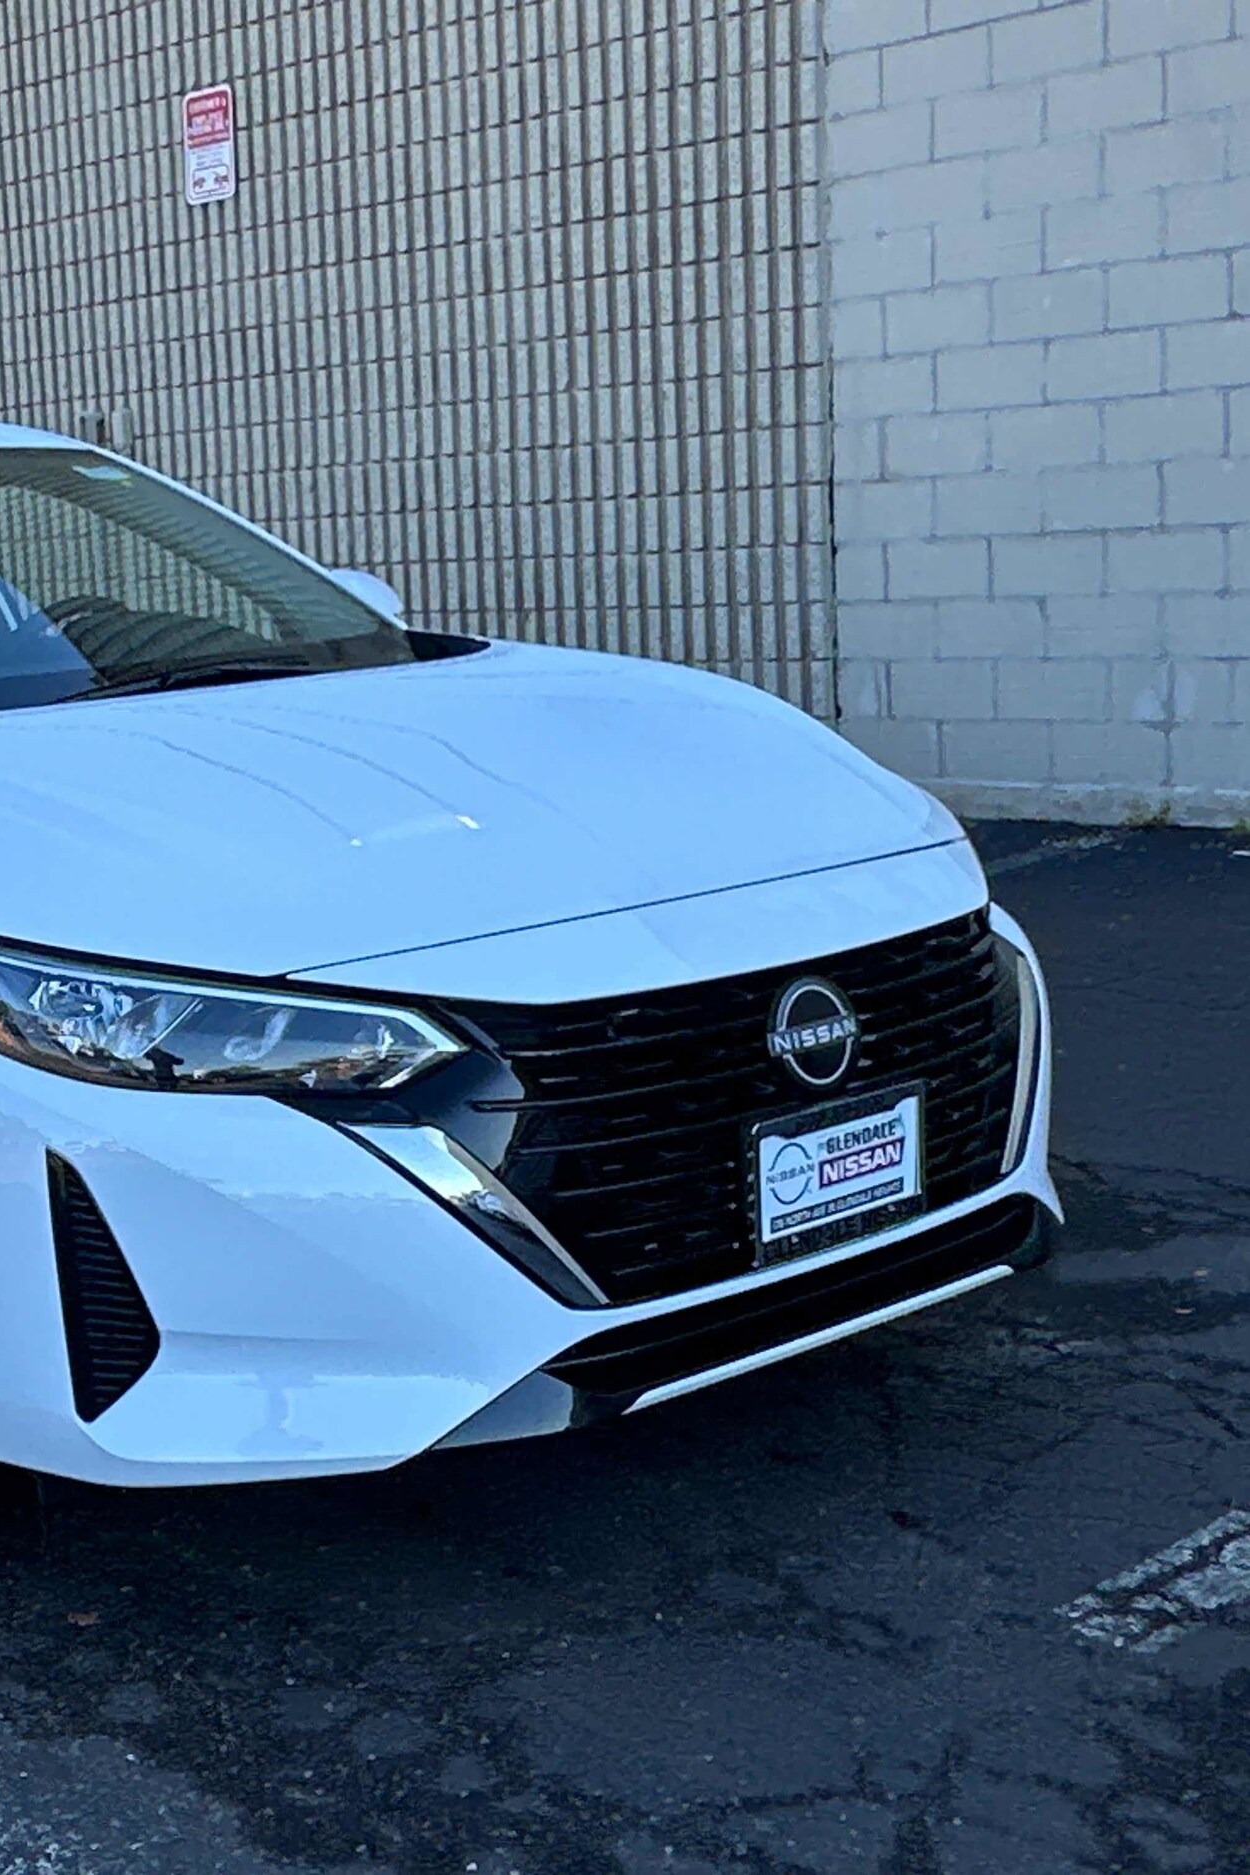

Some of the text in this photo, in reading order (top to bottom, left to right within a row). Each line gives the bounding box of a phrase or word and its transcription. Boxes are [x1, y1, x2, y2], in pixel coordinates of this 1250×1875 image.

[773, 1017, 856, 1054] NISSAN
[826, 1120, 897, 1155] GLENDALE
[822, 1141, 901, 1185] NISSAN
